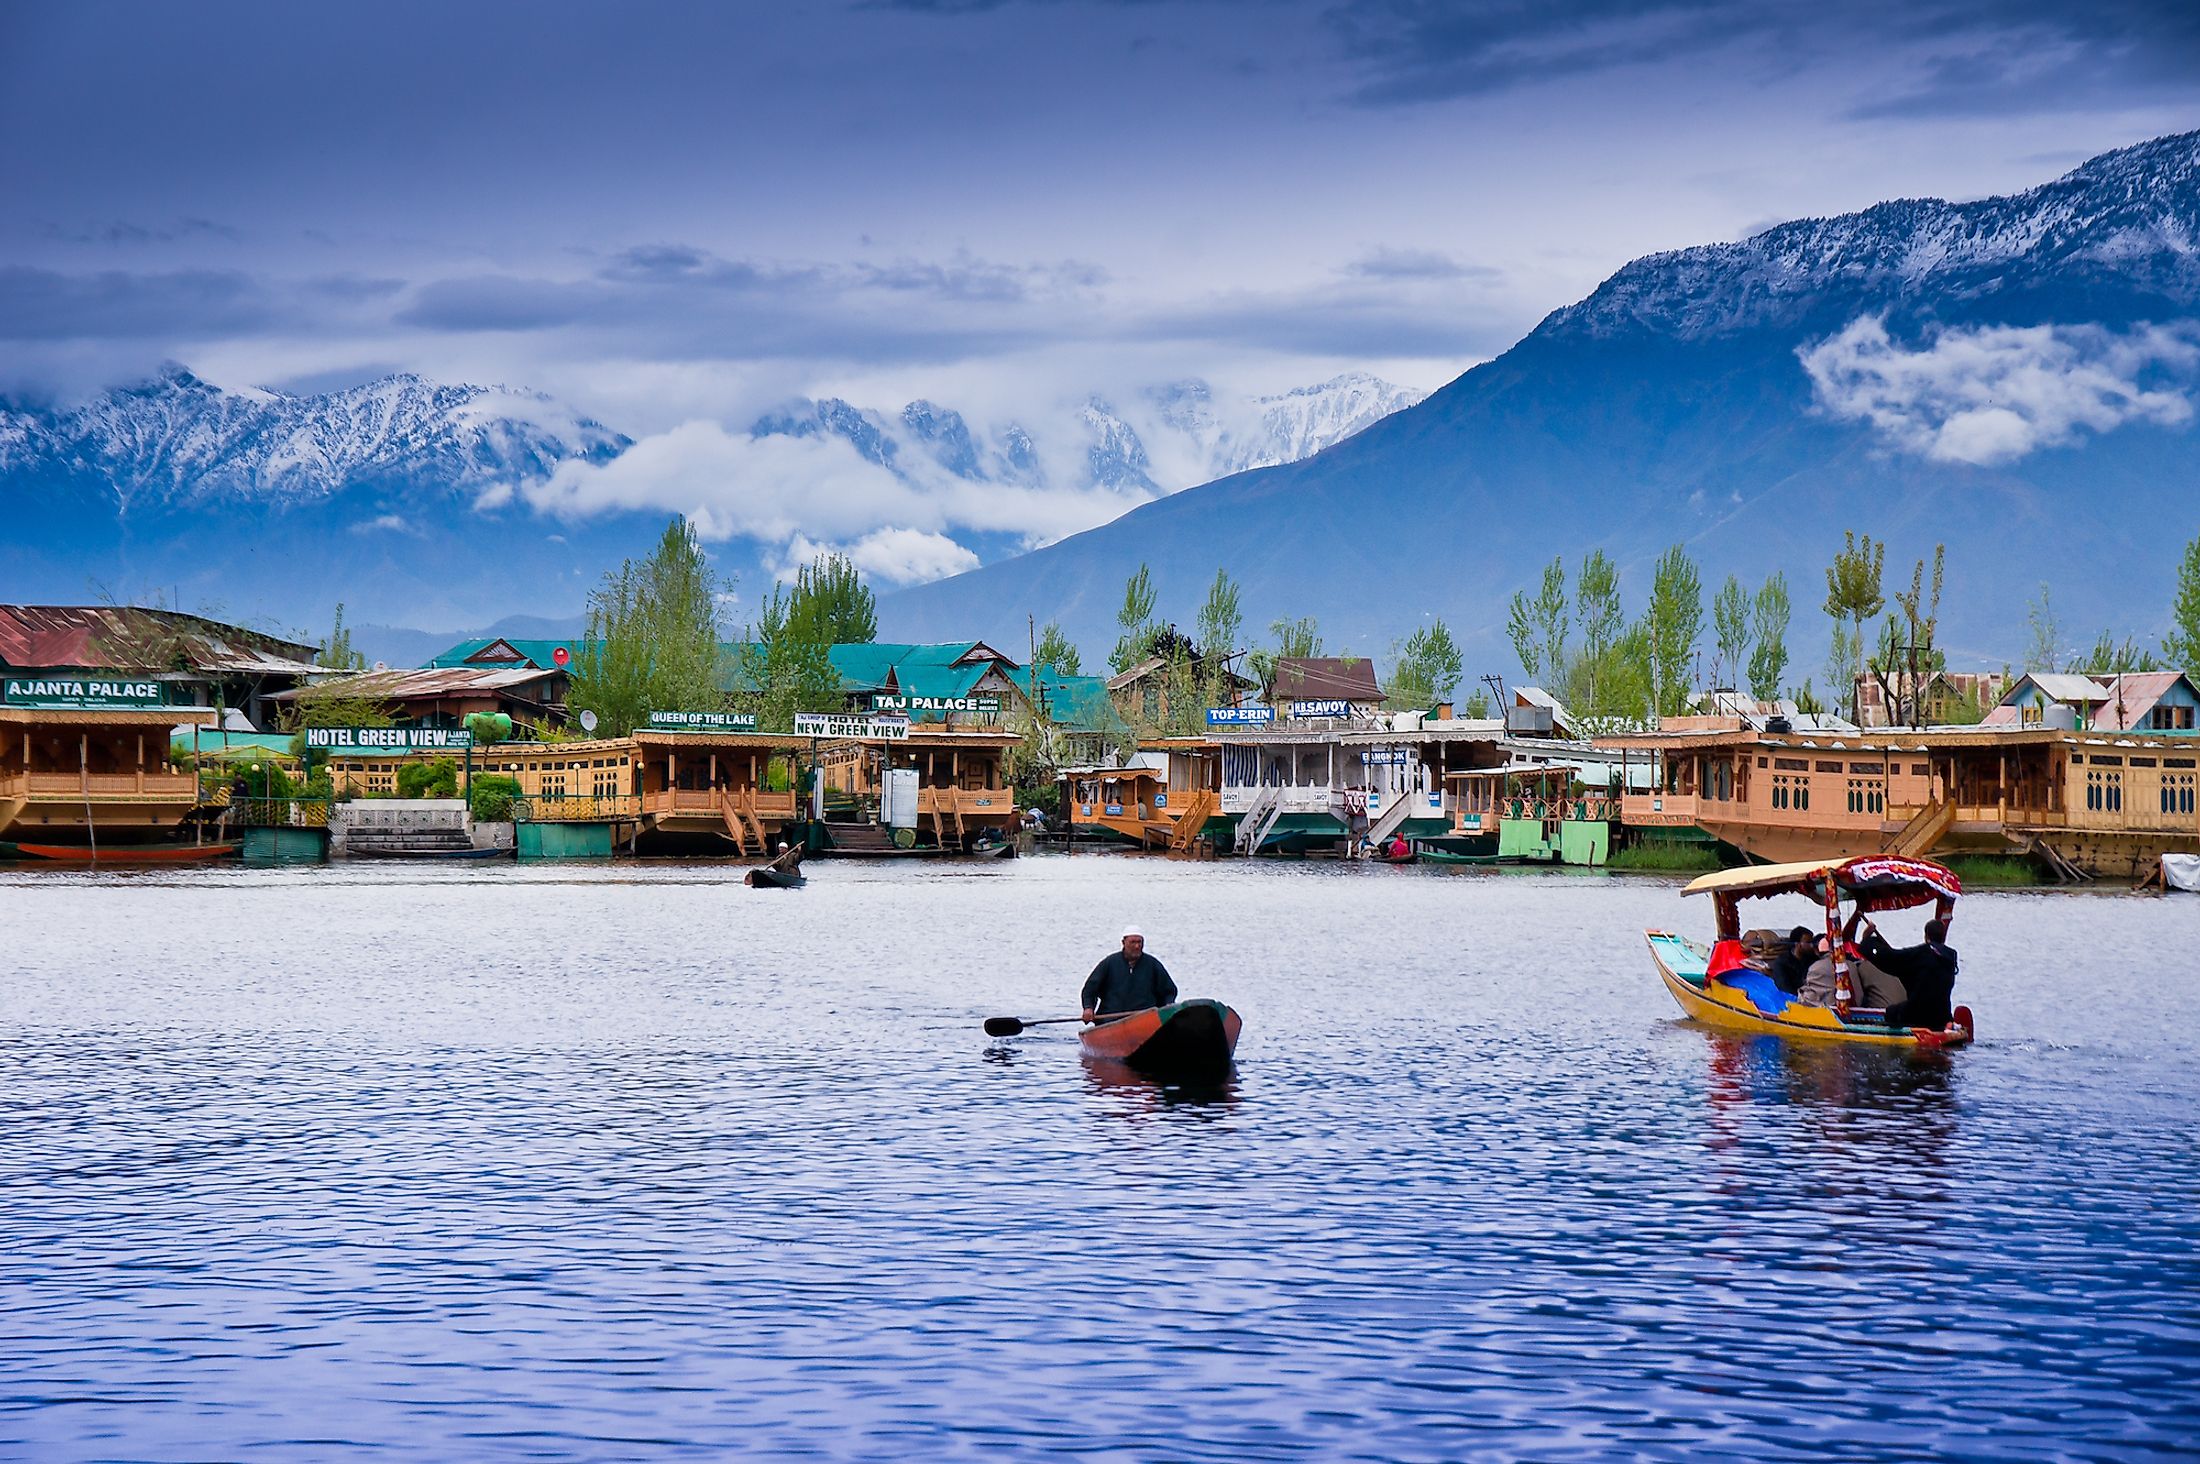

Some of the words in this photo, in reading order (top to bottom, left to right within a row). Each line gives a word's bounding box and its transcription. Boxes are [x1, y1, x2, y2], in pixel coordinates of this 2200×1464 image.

[8, 682, 84, 696] AJANTA
[88, 684, 158, 698] PALACE
[875, 696, 906, 708] TAJ
[912, 697, 977, 711] PALACE
[652, 713, 687, 723] QUEEN
[688, 713, 702, 724] OF
[703, 714, 724, 724] THE
[726, 714, 755, 725] LAKE
[827, 716, 872, 725] HOTEL
[307, 729, 355, 746] HOTEL
[358, 729, 406, 746] GREEN
[409, 729, 447, 746] VIEW
[797, 722, 825, 735] NEW
[829, 723, 868, 737] GREEN
[873, 725, 905, 738] VIEW
